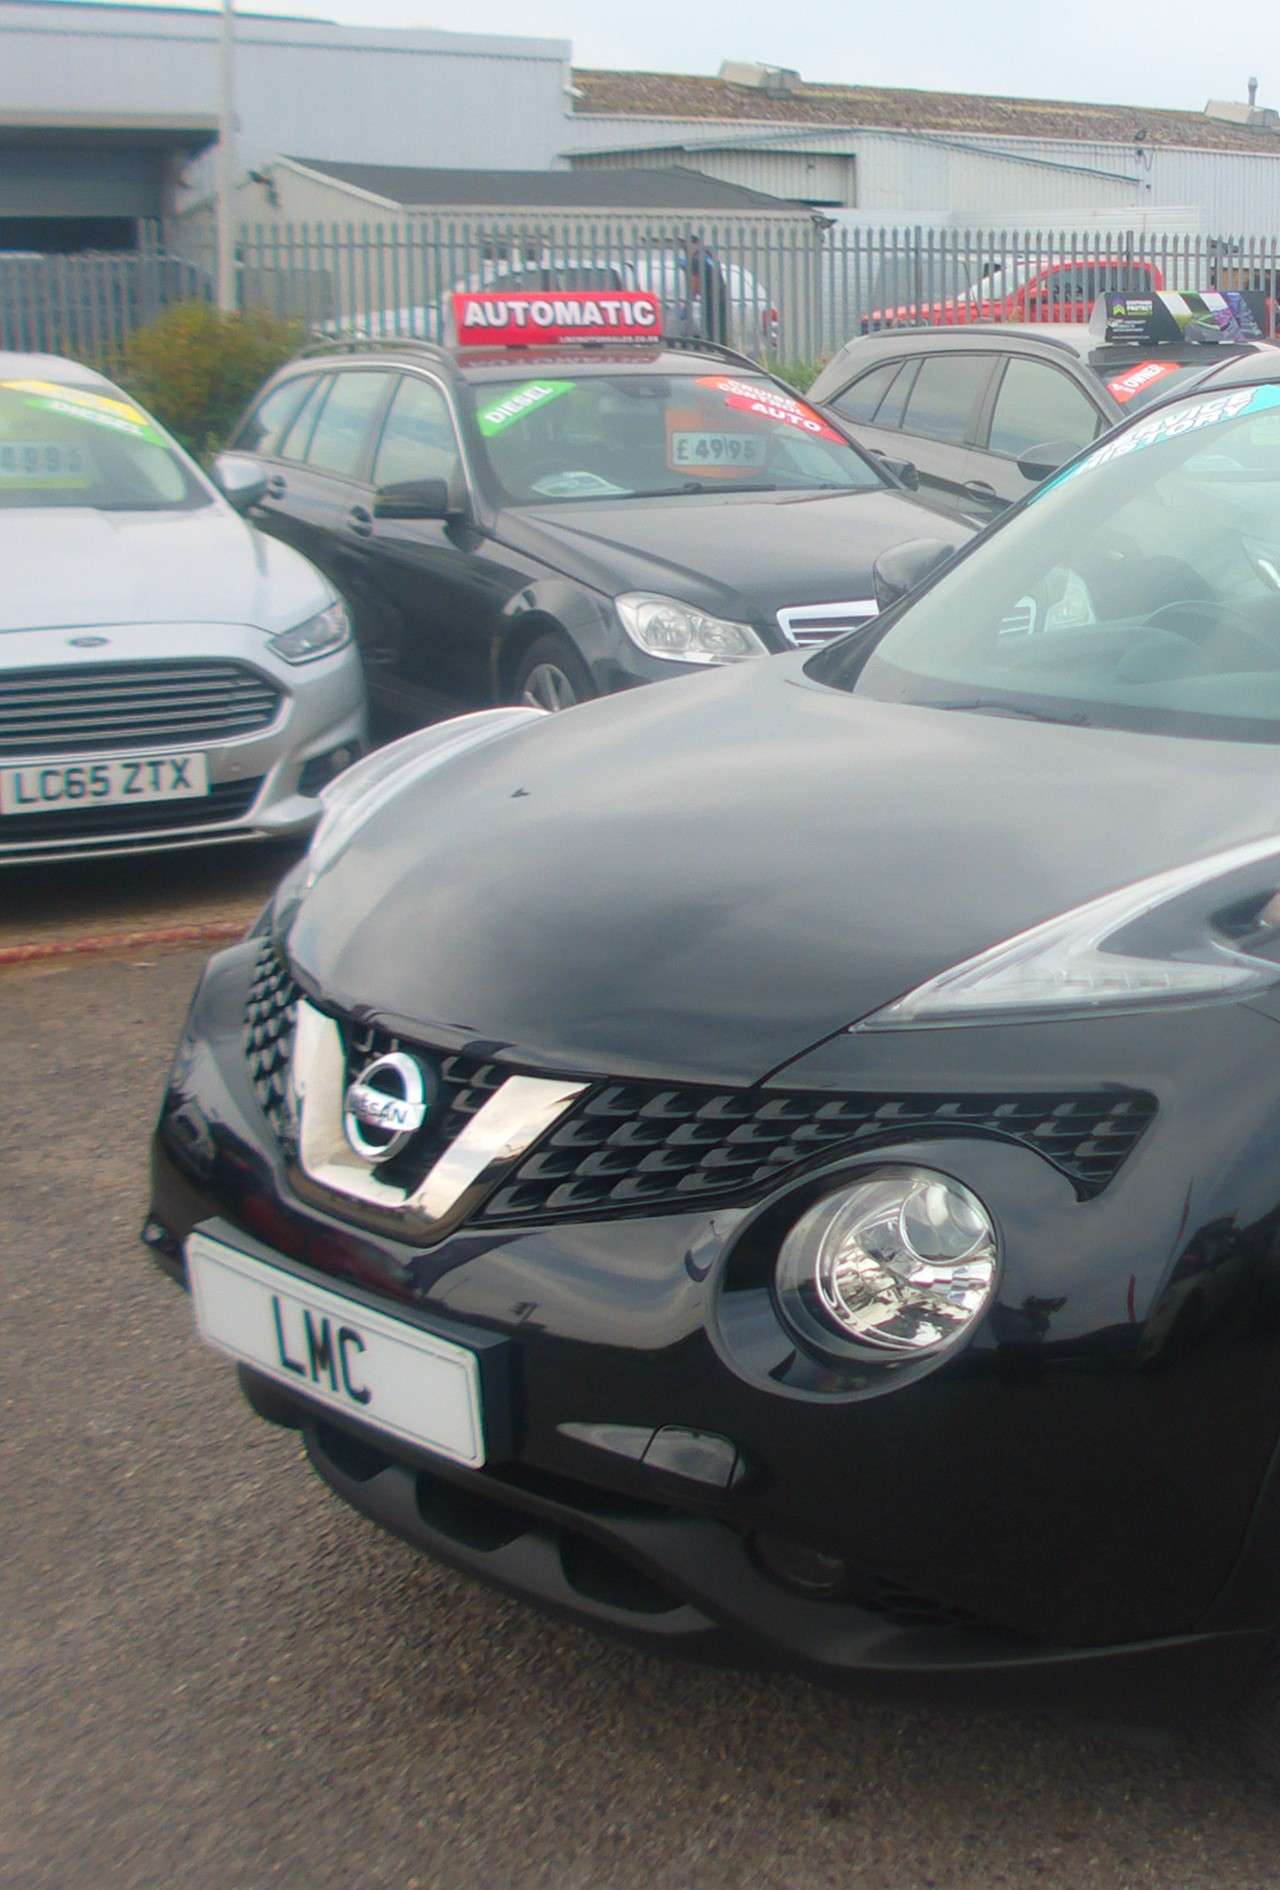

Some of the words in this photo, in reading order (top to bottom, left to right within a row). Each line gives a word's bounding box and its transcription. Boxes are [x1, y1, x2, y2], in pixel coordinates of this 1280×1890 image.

[464, 301, 656, 326] AUTOMATIC
[485, 385, 554, 423] DIESEL
[751, 402, 822, 432] AUTO
[14, 767, 110, 804] LC65
[121, 758, 191, 794] ZTX
[272, 1295, 371, 1406] LMC
